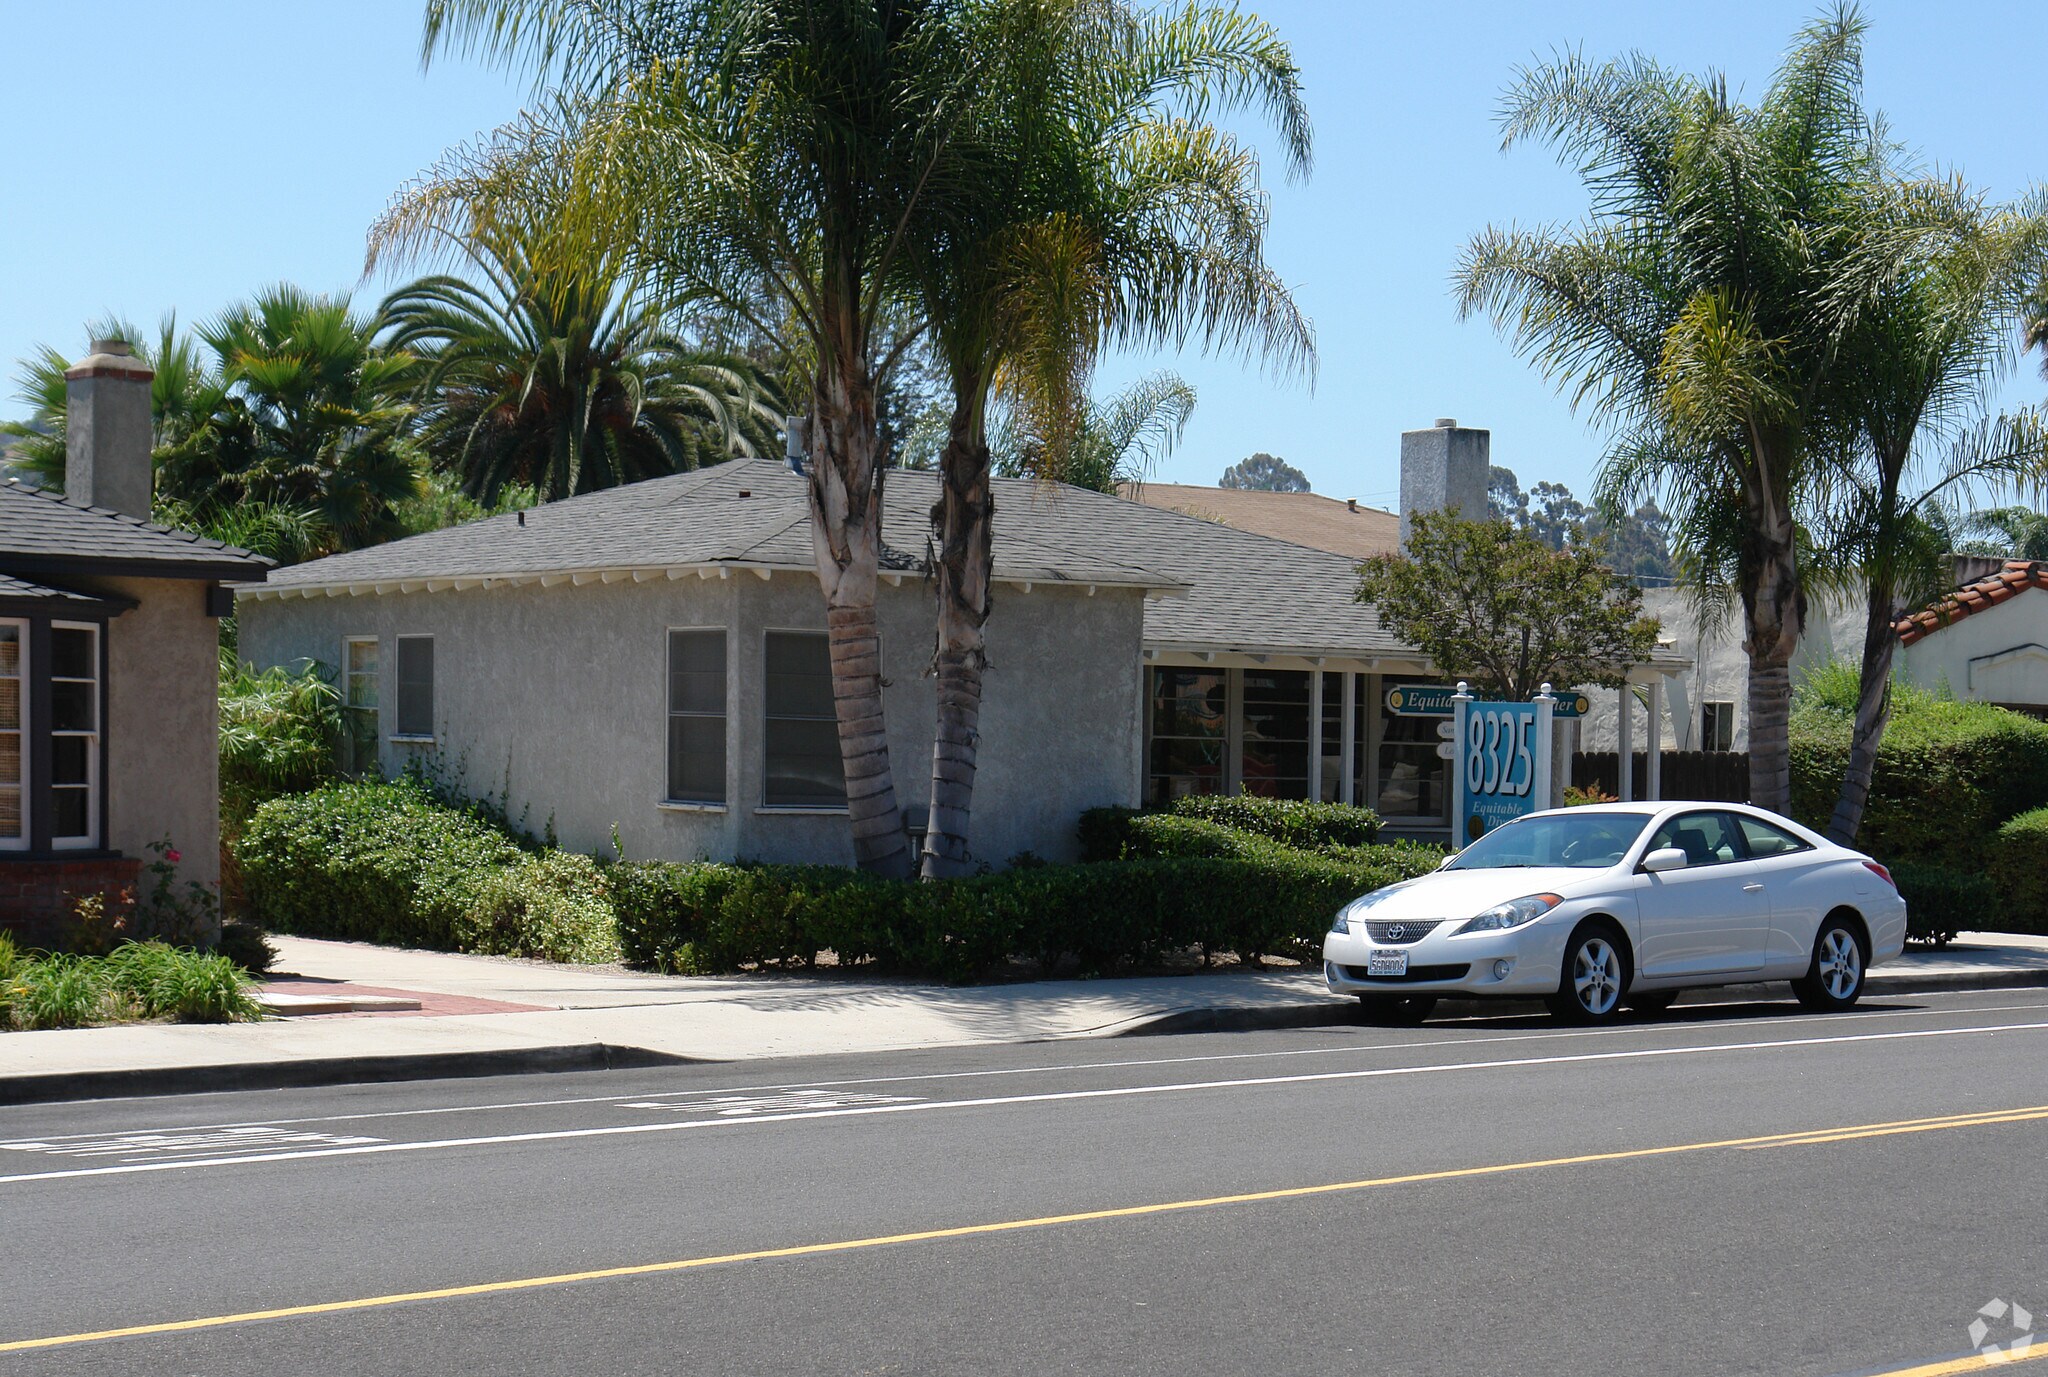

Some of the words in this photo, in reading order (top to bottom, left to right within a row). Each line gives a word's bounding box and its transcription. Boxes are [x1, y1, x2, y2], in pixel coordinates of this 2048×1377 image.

[1407, 692, 1455, 711] Equita
[1554, 700, 1573, 711] ter
[1467, 709, 1535, 798] 8325
[1472, 801, 1523, 816] Equitable
